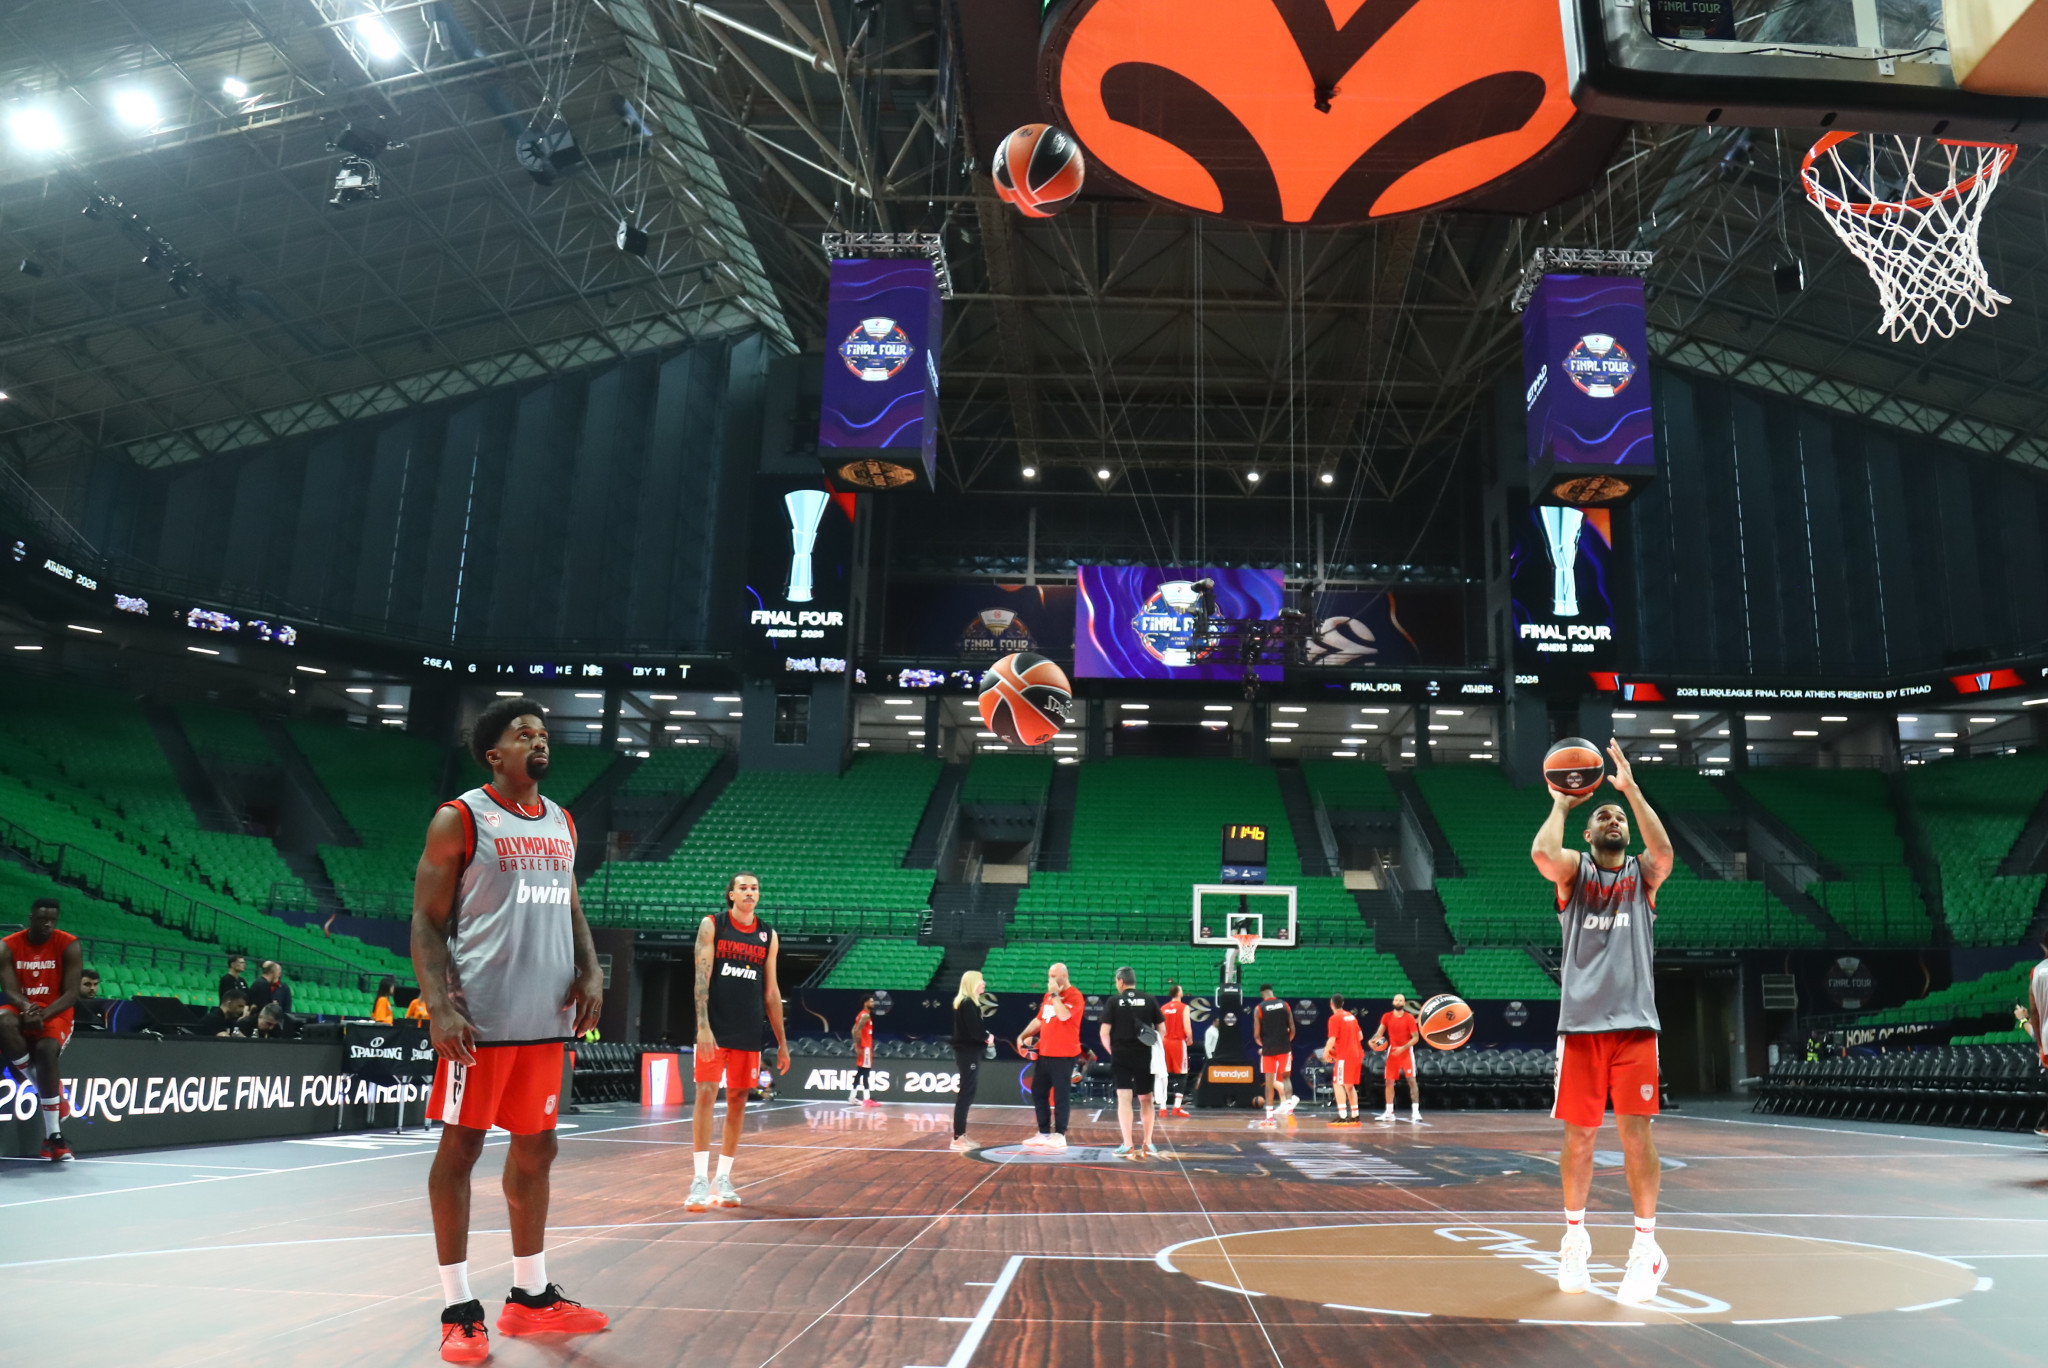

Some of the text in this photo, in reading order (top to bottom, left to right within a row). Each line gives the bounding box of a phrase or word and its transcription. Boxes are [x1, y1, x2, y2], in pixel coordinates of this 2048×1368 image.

[846, 344, 907, 355] FINAL FOUR
[1570, 360, 1629, 372] FINAL FOUR
[44, 559, 97, 590] ATHENS 2026
[751, 610, 843, 626] FINAL FOUR
[1142, 617, 1181, 631] FINAL
[765, 629, 824, 638] ATHENS 2026
[1520, 624, 1612, 640] FINAL FOUR
[1537, 643, 1594, 652] ATHENS 2026
[1350, 682, 1401, 692] FINAL FOUR
[1461, 675, 1539, 693] ATHENS 2026
[1676, 684, 1931, 700] 2026 EUROLEAGUE FINAL FOUR ATHENS PRESENTED BY ETIHAD
[494, 836, 573, 859] OLYMPIACOS
[499, 858, 571, 873] BASKETBAL
[717, 939, 767, 959] OLYMPIACOS
[22, 983, 50, 996] win
[1828, 978, 1872, 988] FINAL FOUR
[1846, 1028, 1876, 1048] HOME
[350, 1045, 403, 1060] SPALDING
[1212, 1070, 1249, 1082] trendyol
[234, 1075, 295, 1111] FINAL
[300, 1074, 352, 1107] FOUR
